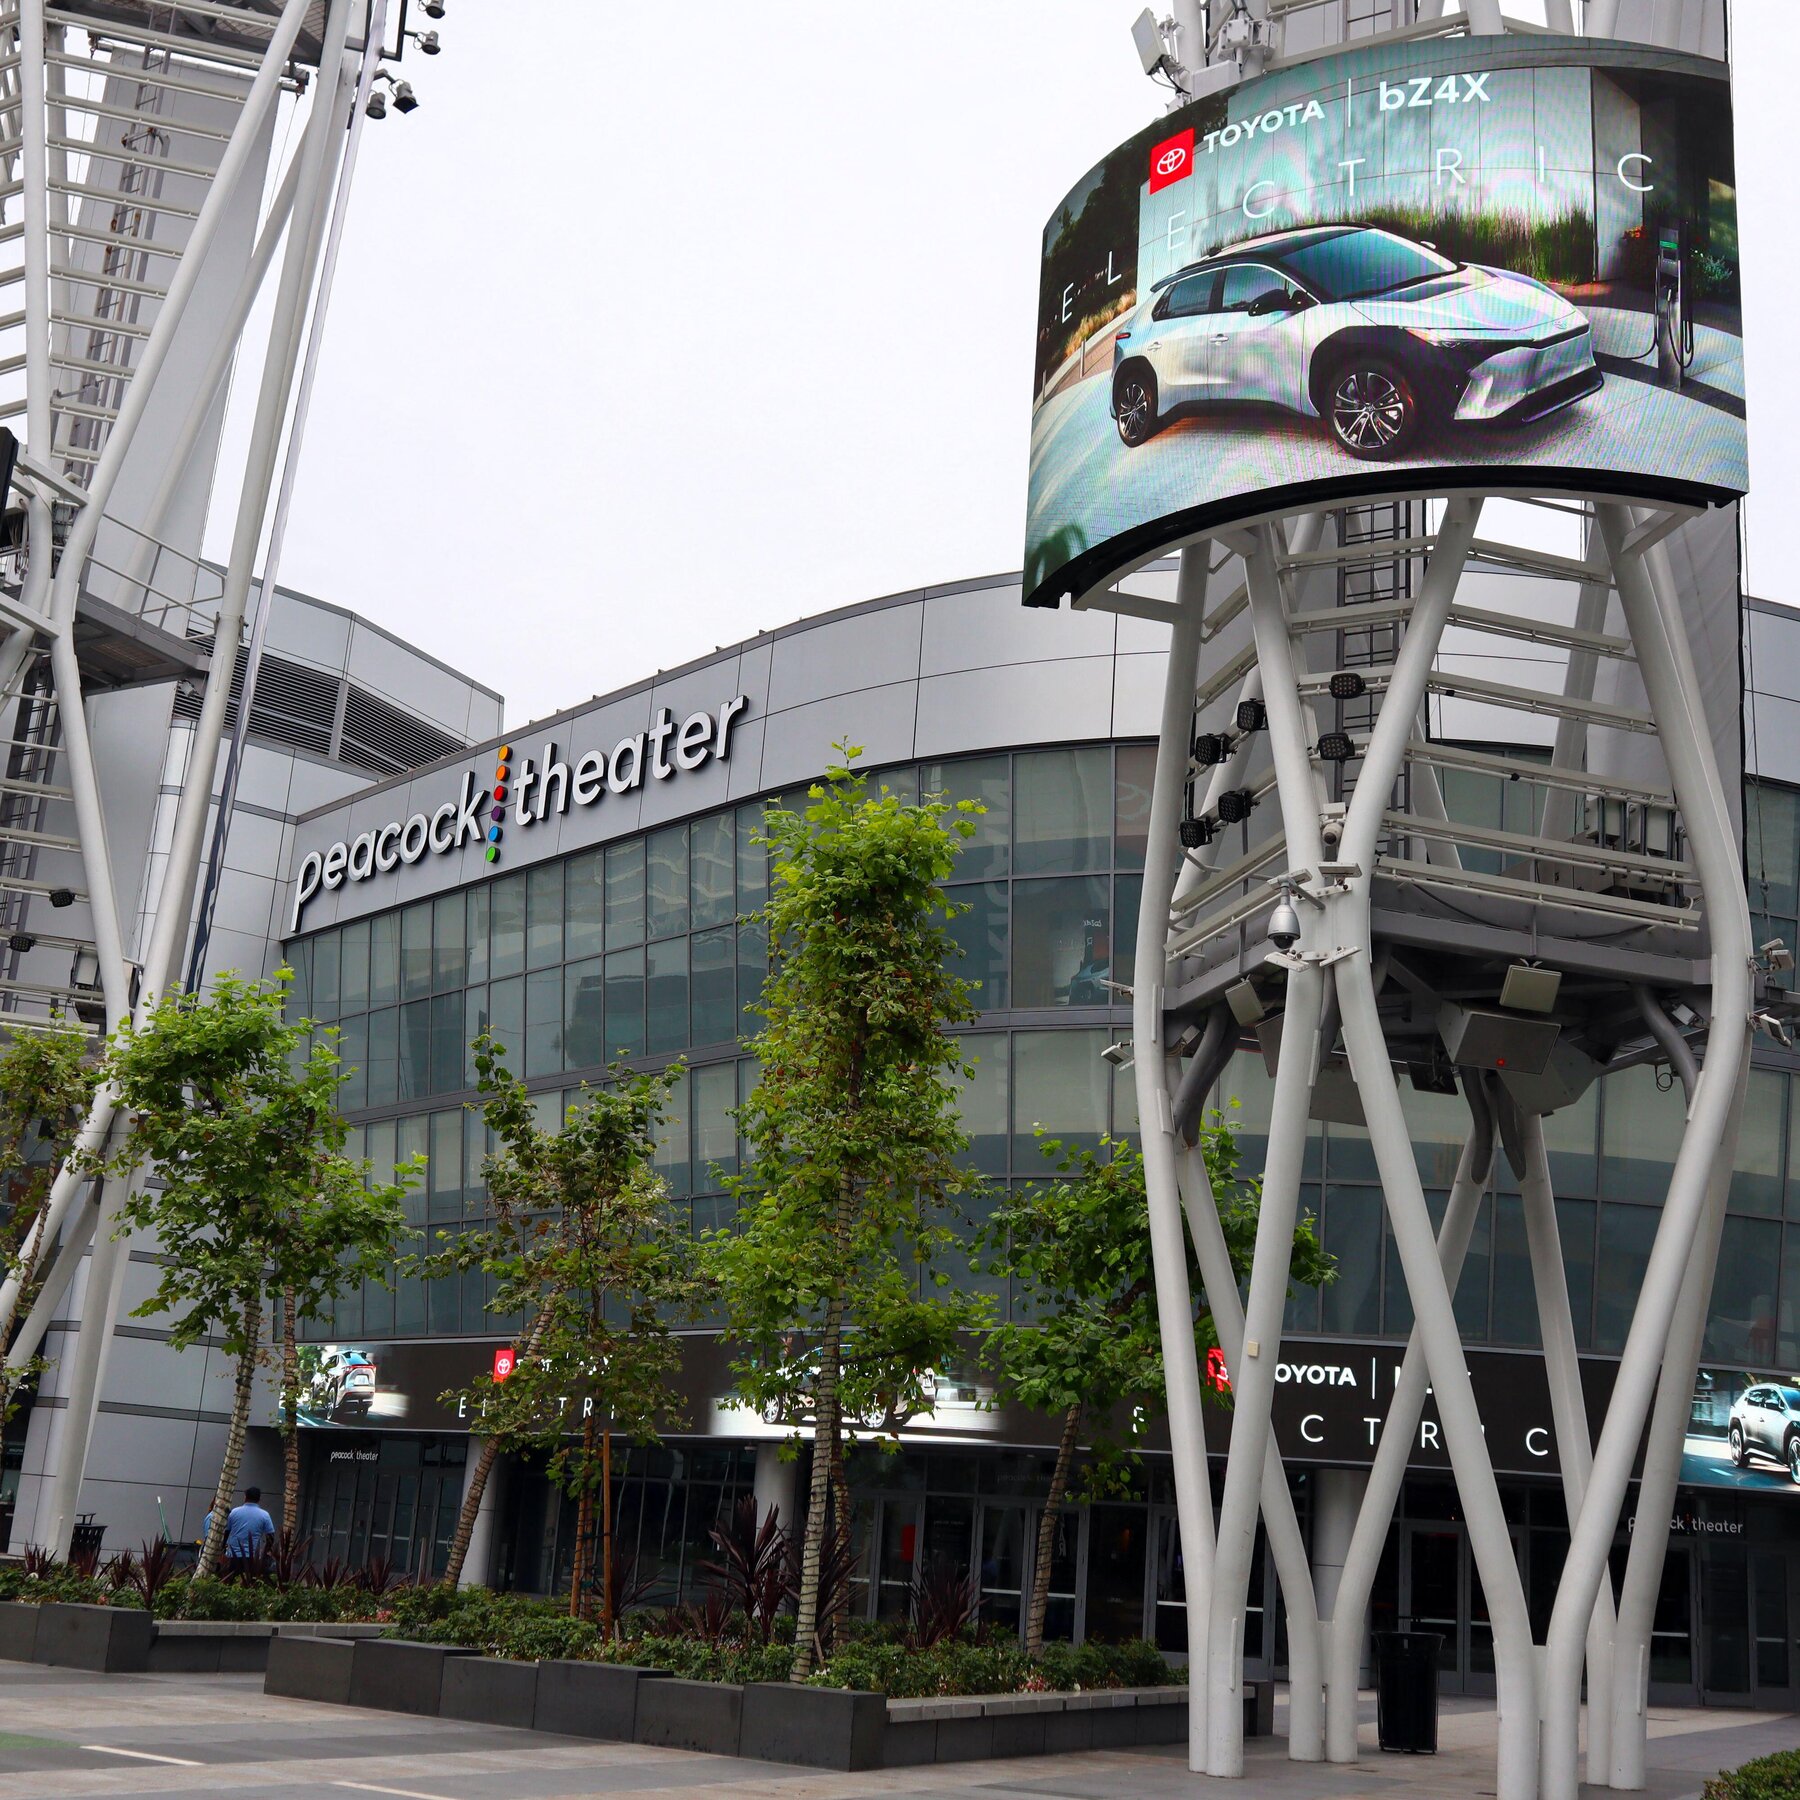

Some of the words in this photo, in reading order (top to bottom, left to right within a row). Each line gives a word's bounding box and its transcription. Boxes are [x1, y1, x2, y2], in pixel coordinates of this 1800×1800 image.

[1203, 100, 1325, 153] TOYOTA
[1379, 73, 1490, 111] bZ4X
[1062, 145, 1654, 323] ELECTRIC
[291, 771, 490, 932] peacock
[513, 695, 748, 827] theater
[1274, 1363, 1357, 1386] OYOTA
[330, 1449, 354, 1462] peacock
[356, 1449, 379, 1461] theater
[1691, 1516, 1744, 1533] theater
